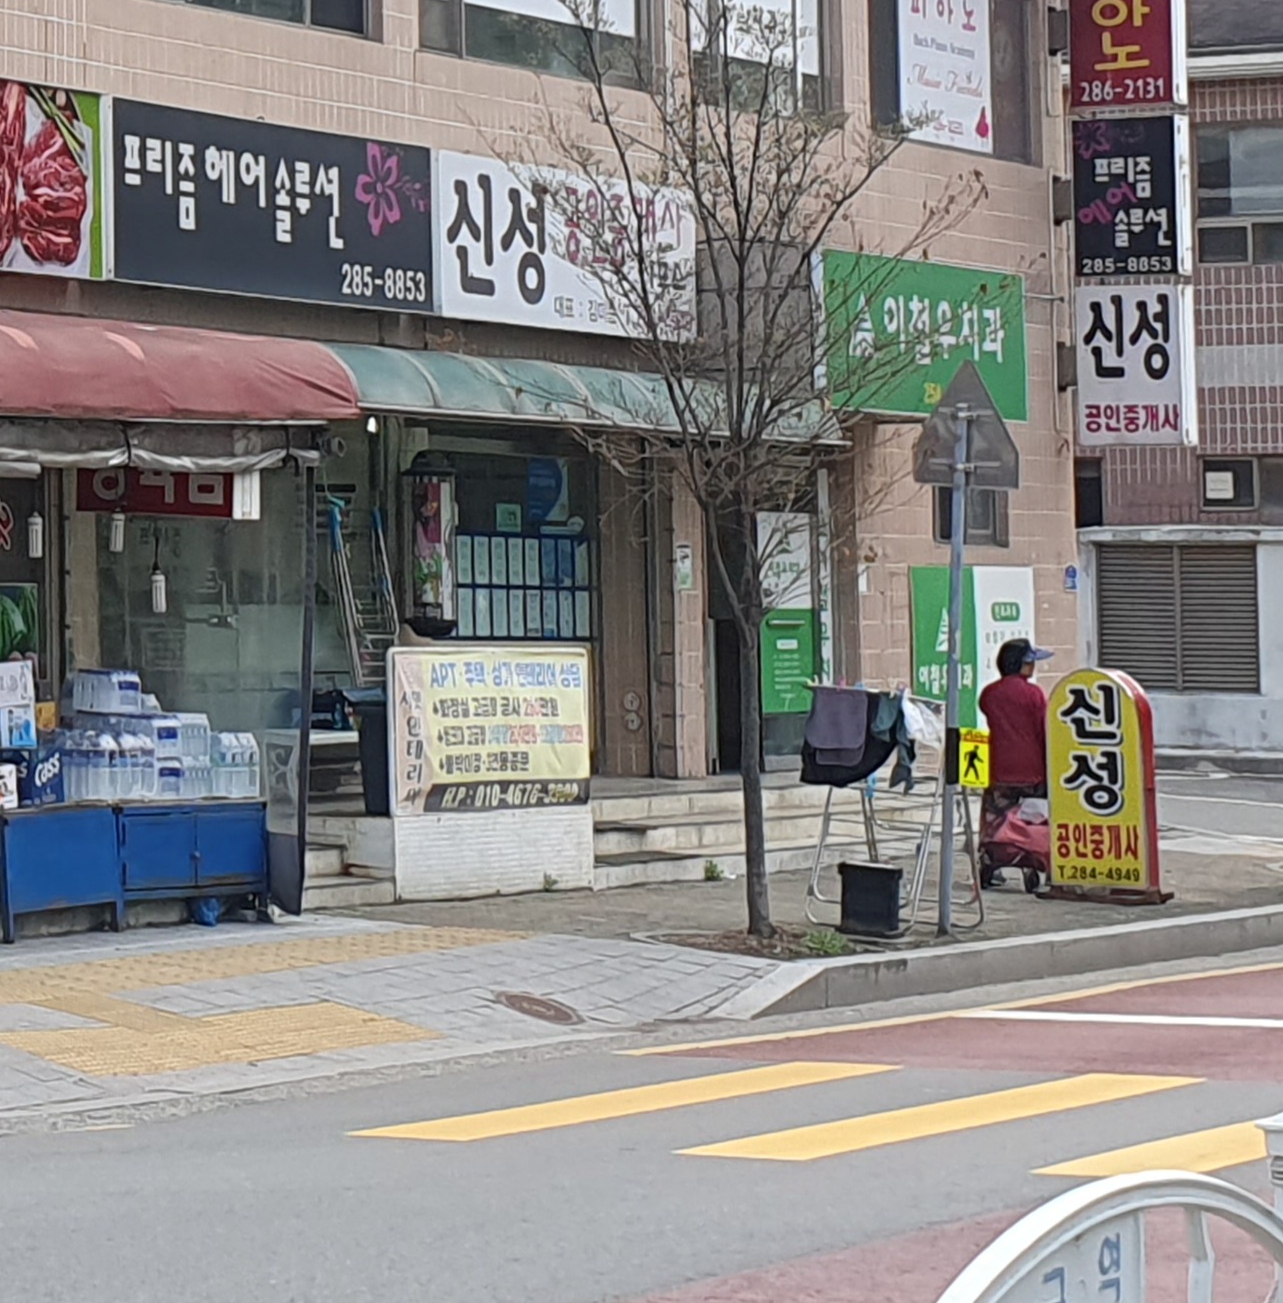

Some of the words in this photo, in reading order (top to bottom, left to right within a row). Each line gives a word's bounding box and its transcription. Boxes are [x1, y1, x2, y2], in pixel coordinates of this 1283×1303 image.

[1079, 77, 1165, 103] 286-2131
[1092, 155, 1151, 199] 프리즘
[446, 172, 547, 306] 신성
[1114, 207, 1173, 248] 솔루션
[340, 264, 427, 303] 285-8853
[1081, 255, 1173, 274] 285-8853
[883, 294, 1005, 366] 이철우치과
[1082, 293, 1171, 380] 신성
[1083, 402, 1180, 435] 공인중개사
[1059, 683, 1123, 812] 신성
[34, 751, 61, 788] Cass
[1056, 822, 1140, 861] 공인중개사
[1056, 864, 1141, 883] T.284-4949
